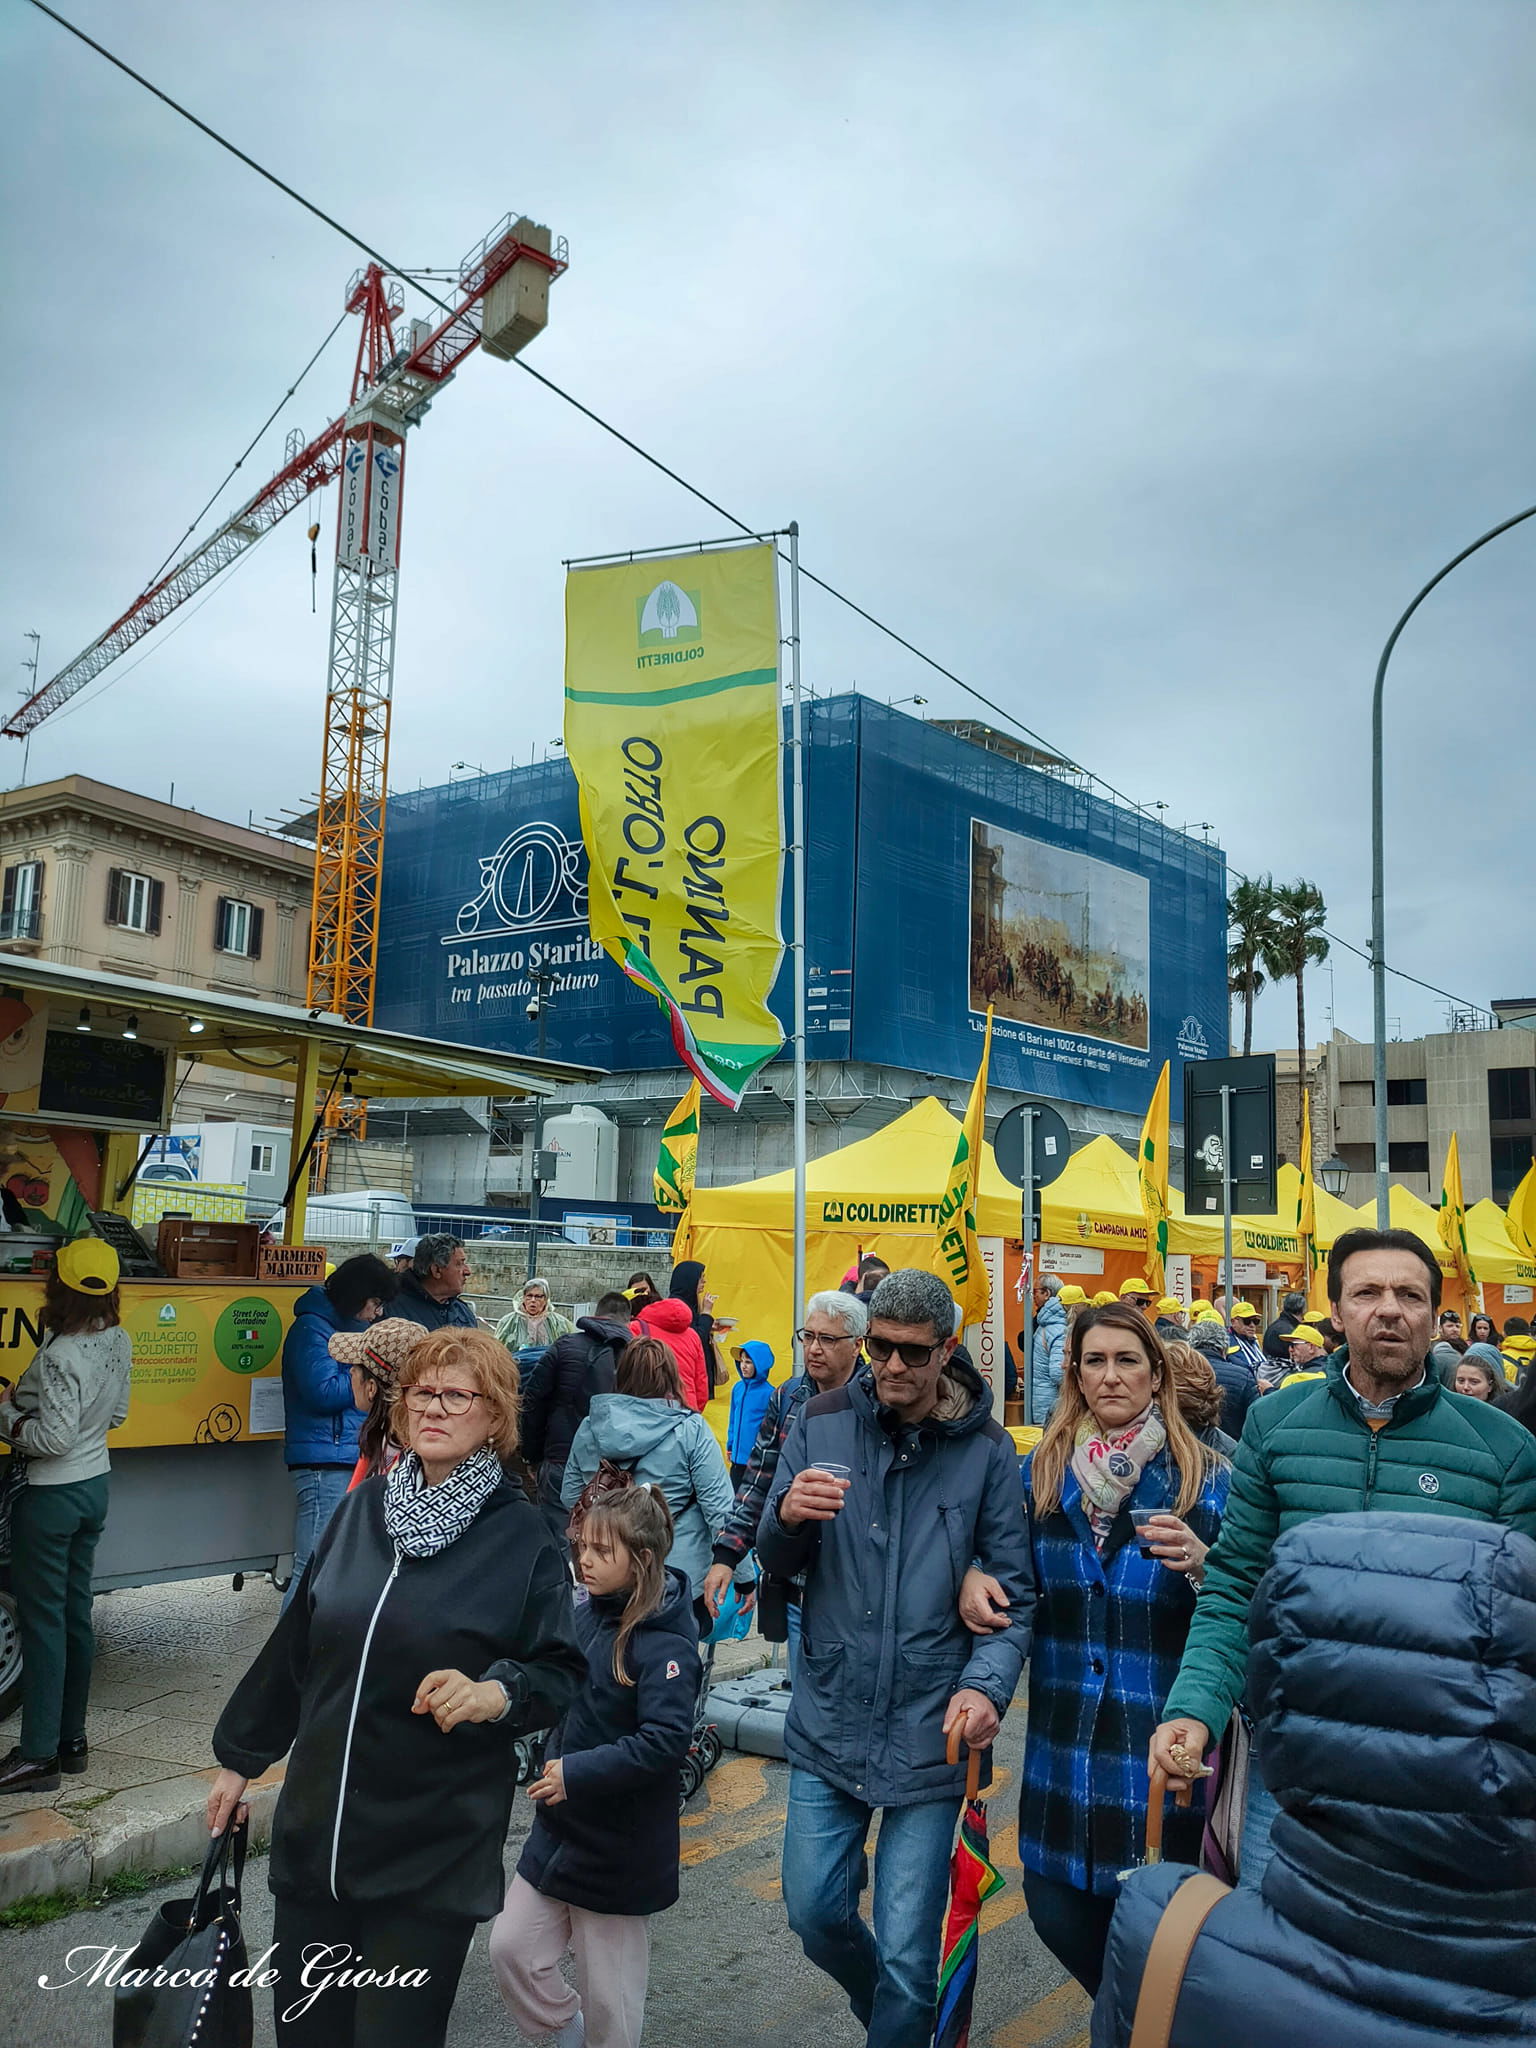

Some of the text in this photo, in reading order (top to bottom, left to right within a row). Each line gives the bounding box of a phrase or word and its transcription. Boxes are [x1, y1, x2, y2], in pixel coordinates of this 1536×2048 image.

[347, 477, 357, 559] cobar
[378, 481, 389, 559] cobar
[447, 934, 604, 978] Palazzo Starita
[451, 986, 471, 1003] tra
[477, 979, 531, 1004] passato
[1018, 1030, 1026, 1042] di
[1026, 1032, 1043, 1045] Bari
[1043, 1036, 1056, 1049] nel
[1056, 1038, 1076, 1052] 1002
[1077, 1042, 1088, 1055] da
[1088, 1046, 1106, 1060] parte
[1106, 1049, 1118, 1061] dei
[1021, 1047, 1052, 1060] RAFFAELE
[1052, 1053, 1083, 1067] ARMENISE
[847, 1203, 941, 1224] COLDIRETT
[1094, 1222, 1148, 1240] CAMPAGNA AMIC
[1256, 1233, 1299, 1253] COLDIRETTI
[264, 1248, 324, 1263] FARMERS
[266, 1262, 320, 1276] MARKET
[232, 1309, 269, 1319] Street Food
[233, 1317, 266, 1326] Contadino
[136, 1331, 197, 1343] VILLAGGIO
[132, 1344, 198, 1355] COLDIRETTI
[240, 1356, 252, 1366] €3
[153, 1367, 197, 1377] ITALIANO
